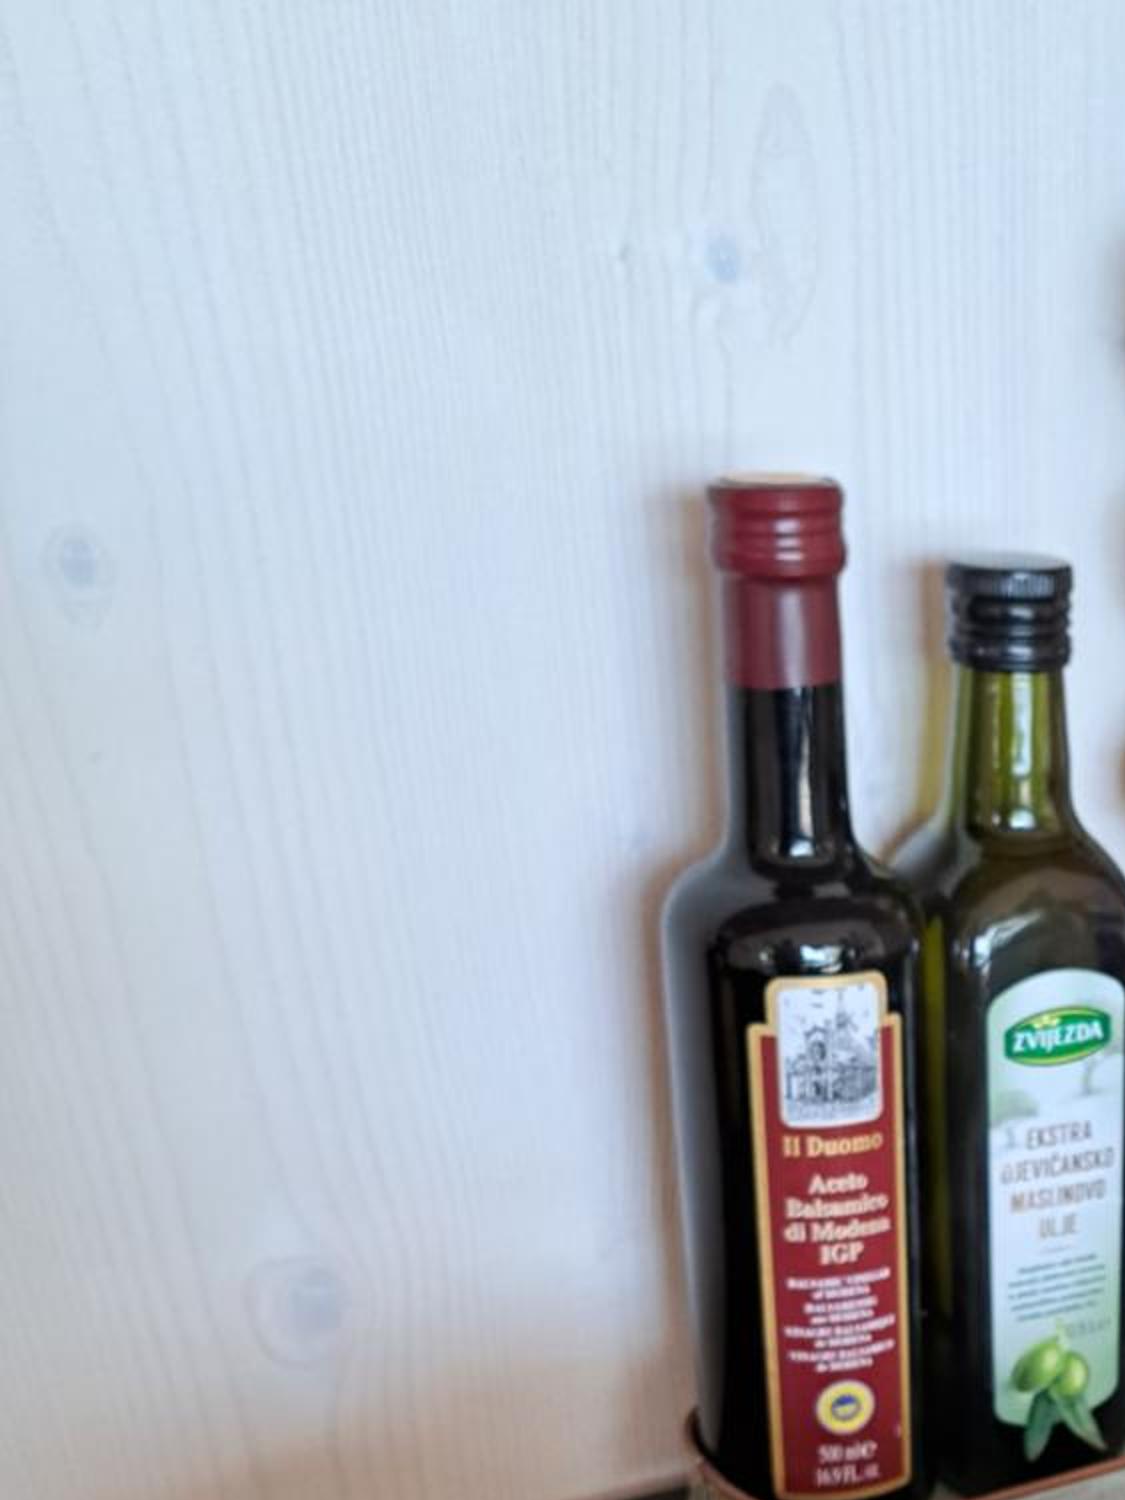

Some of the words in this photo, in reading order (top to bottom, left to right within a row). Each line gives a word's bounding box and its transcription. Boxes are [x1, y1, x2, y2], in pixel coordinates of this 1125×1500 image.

[1012, 1020, 1104, 1053] ZVIJEZDA
[806, 1132, 884, 1157] Duomo
[1026, 1120, 1091, 1149] EKSTRA
[808, 1173, 868, 1194] Aceto
[785, 1190, 890, 1219] Balsamico
[784, 1220, 807, 1242] di
[810, 1216, 891, 1243] Modena
[819, 1241, 865, 1266] IGP
